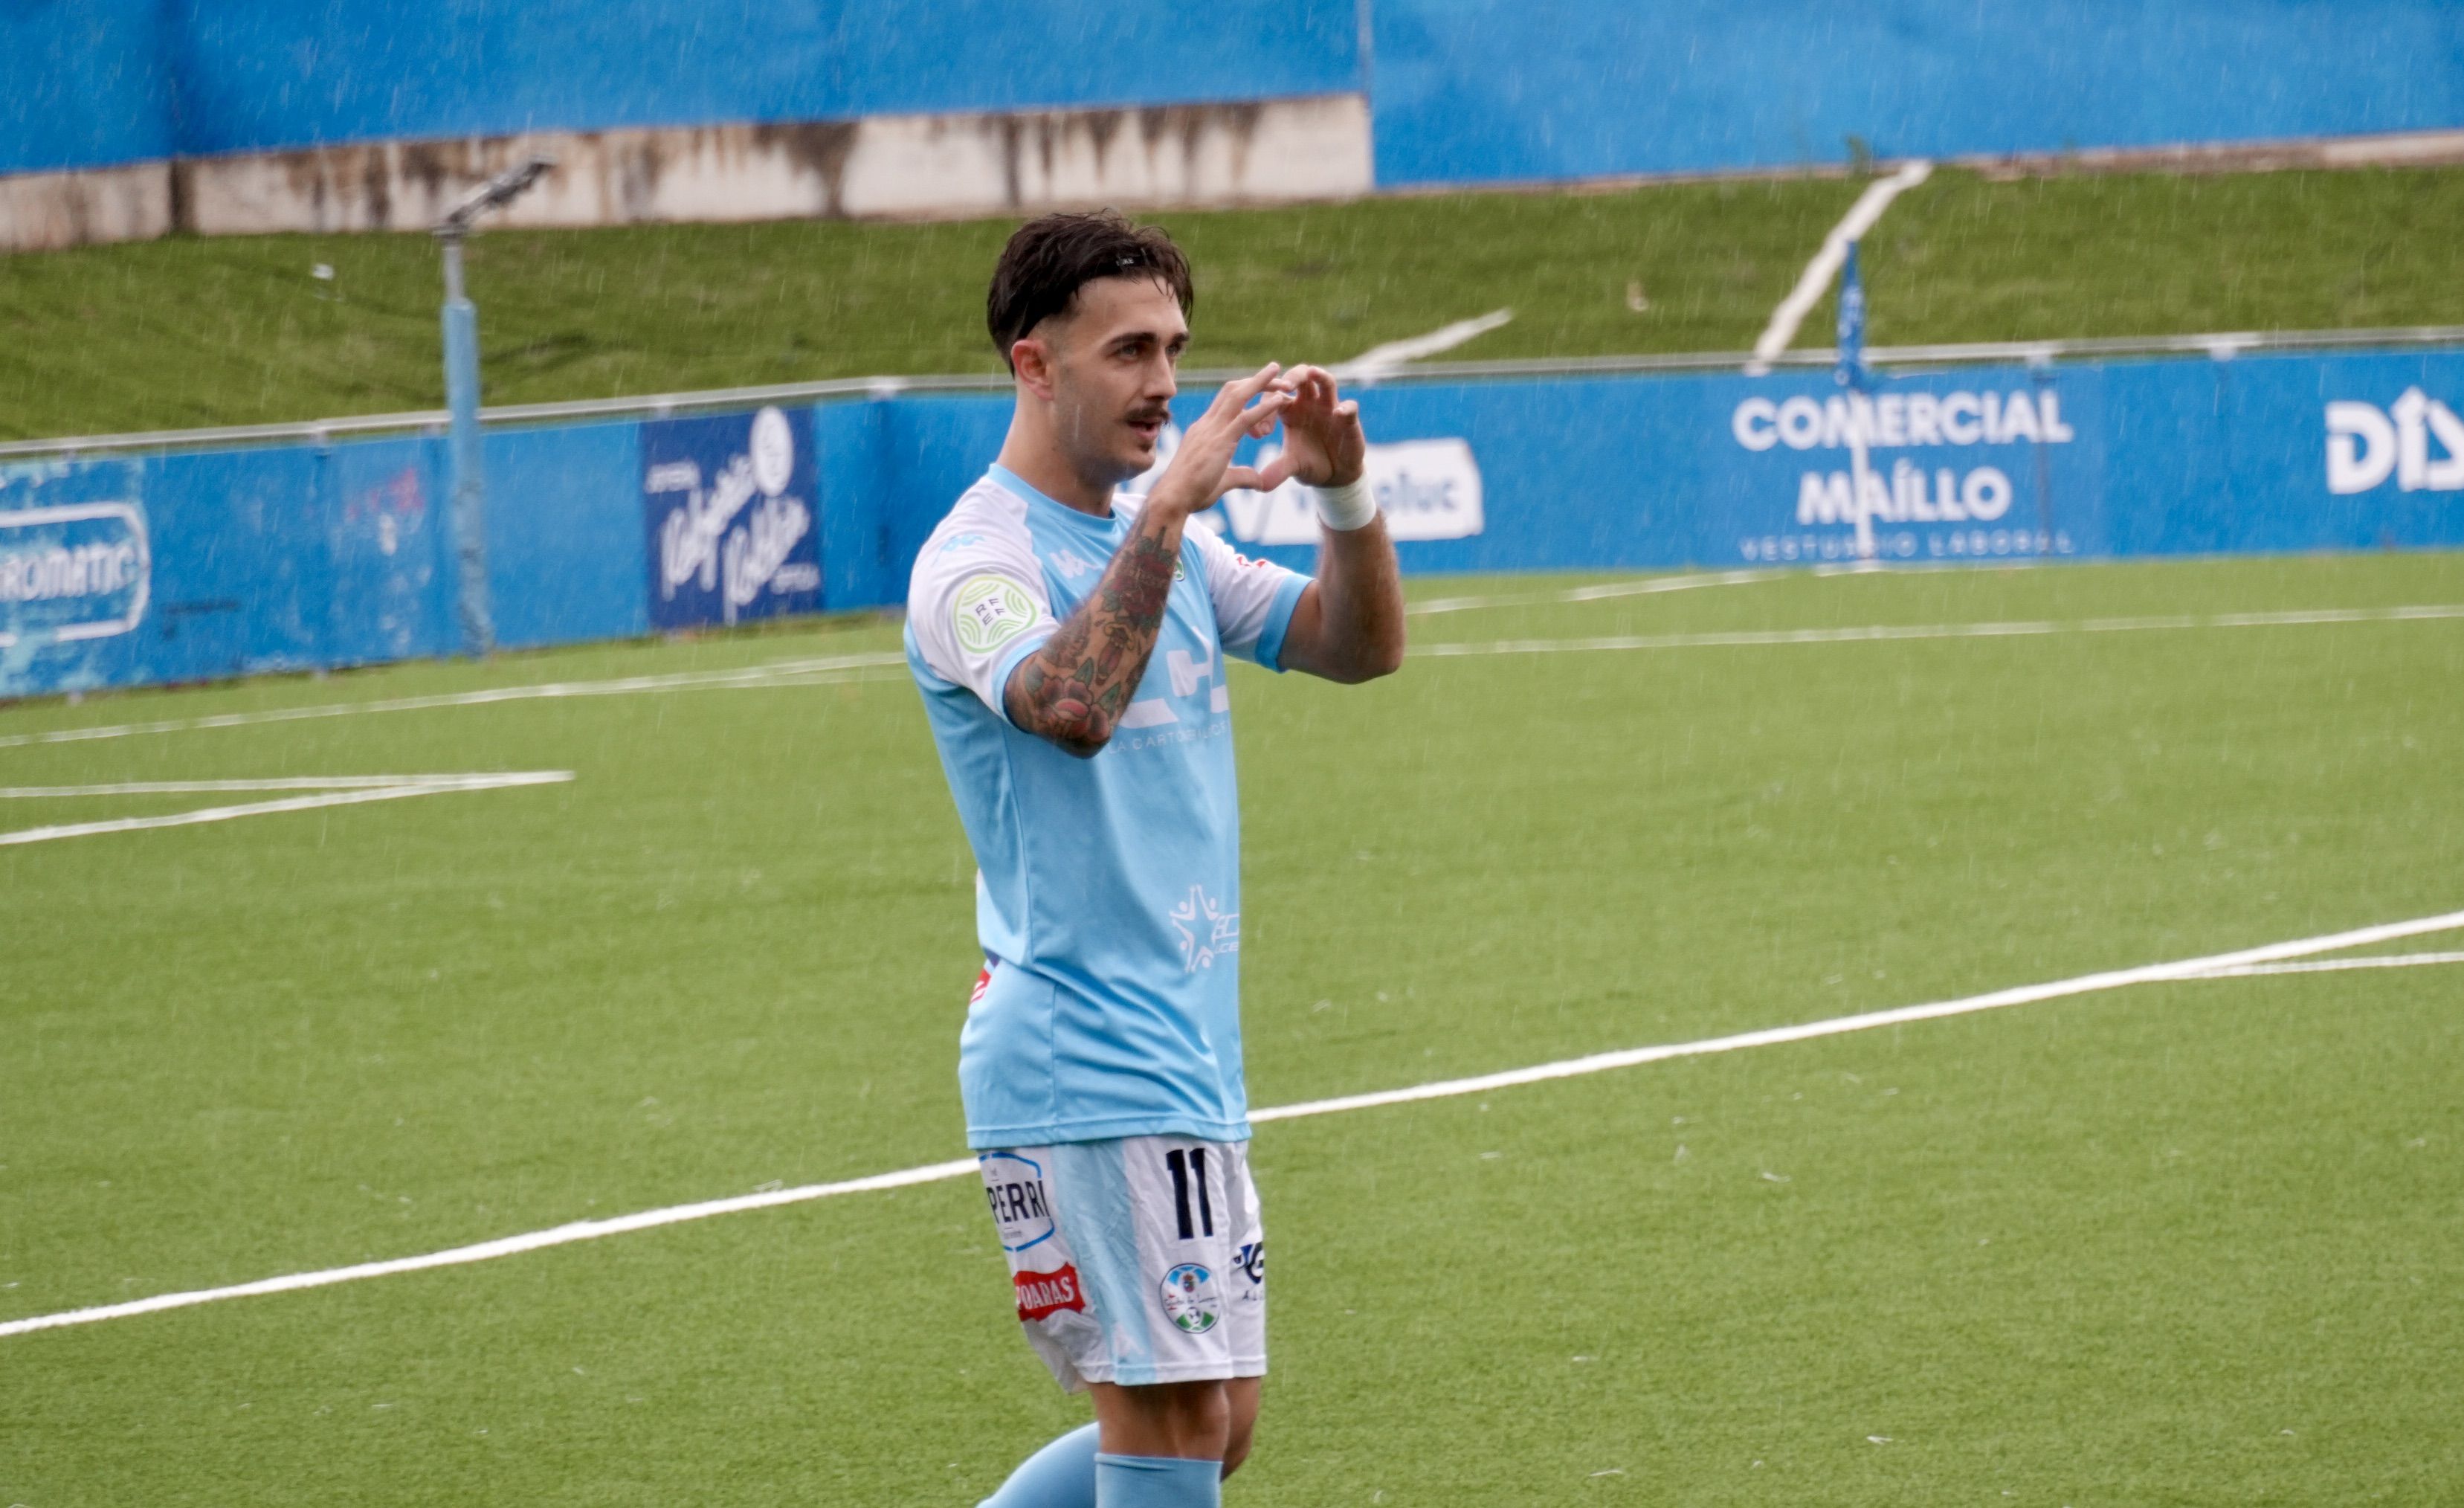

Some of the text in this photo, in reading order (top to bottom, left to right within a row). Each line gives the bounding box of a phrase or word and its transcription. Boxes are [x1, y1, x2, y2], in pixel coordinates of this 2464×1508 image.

[1732, 390, 2074, 451] COMERCIAL
[1740, 532, 1918, 561] VESTUAIO
[986, 1179, 1050, 1225] PERRI
[1166, 1147, 1213, 1240] 11
